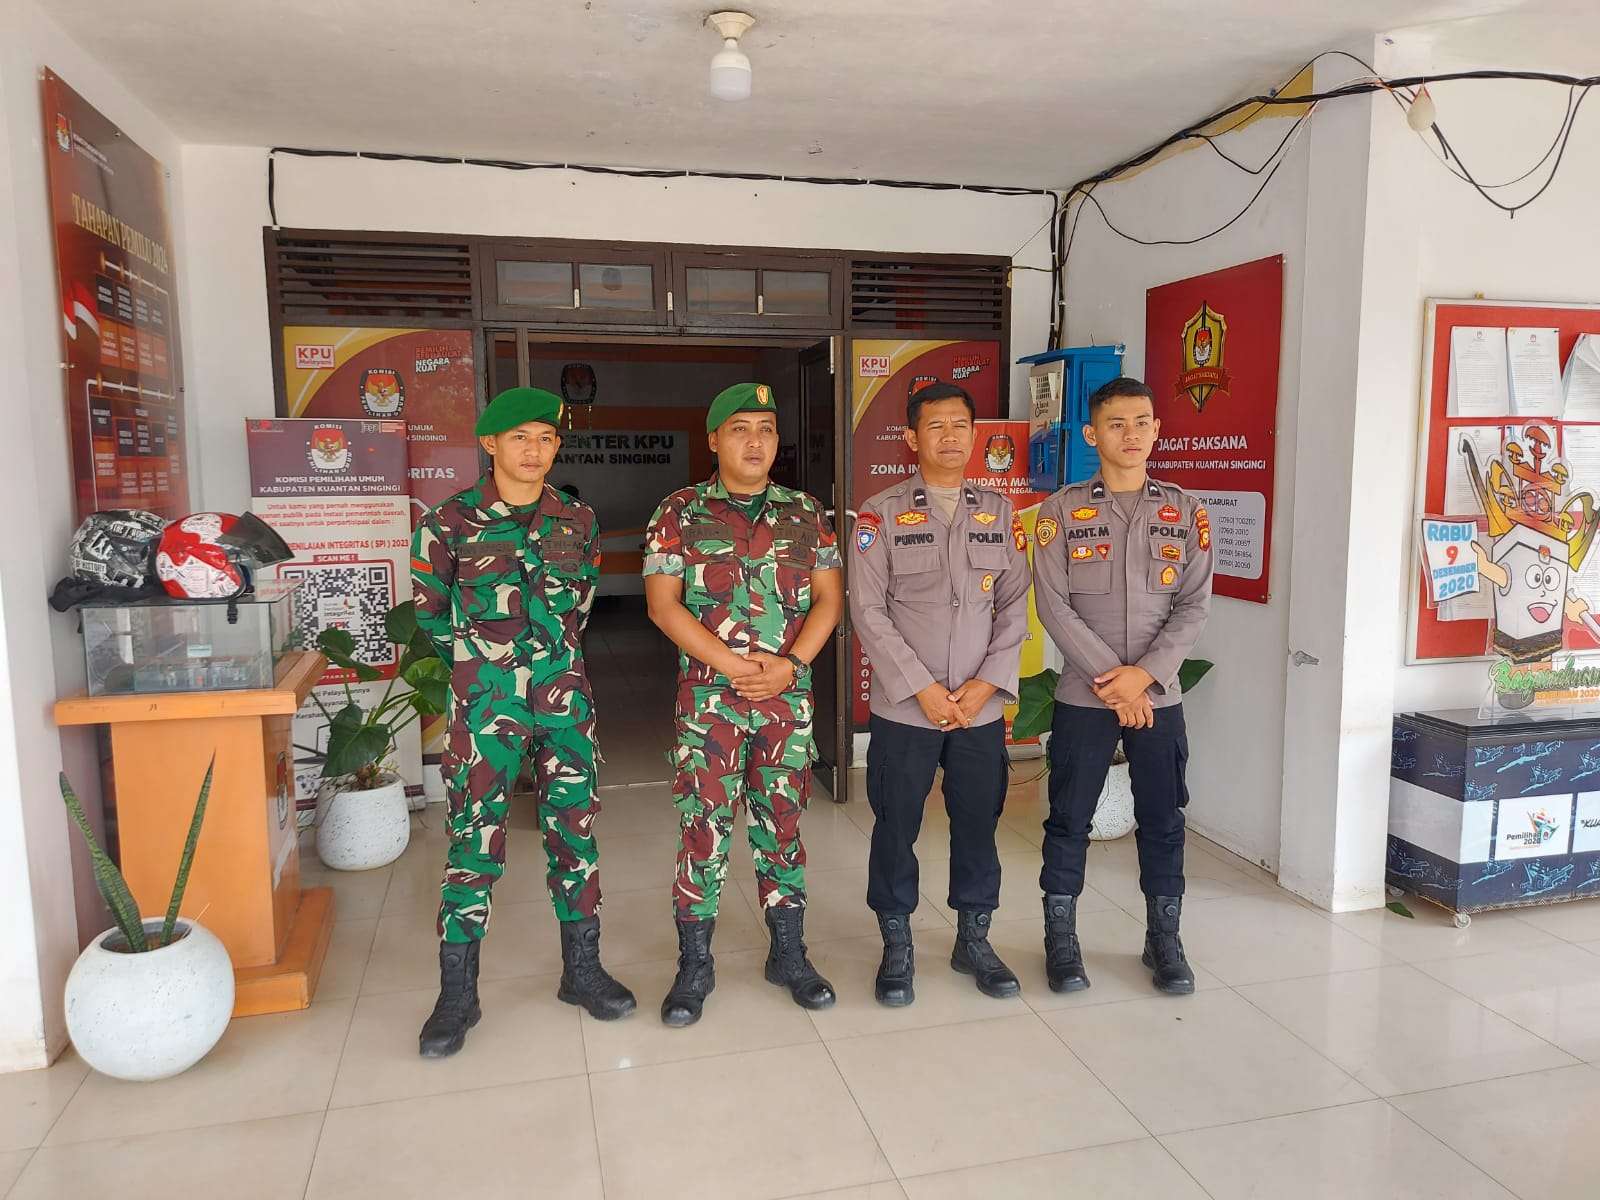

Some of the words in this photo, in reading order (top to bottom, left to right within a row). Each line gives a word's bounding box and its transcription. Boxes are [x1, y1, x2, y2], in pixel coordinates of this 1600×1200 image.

[72, 192, 120, 248] TAHAPAN
[298, 348, 331, 358] KPU
[416, 357, 450, 367] NEGARA
[861, 358, 887, 368] KPU
[416, 364, 437, 373] KUAT
[953, 365, 980, 374] NEGARA
[633, 434, 674, 449] KPU
[1157, 437, 1190, 452] JAGAT
[1192, 434, 1248, 450] SAKSANA
[554, 454, 605, 465] ANTAN
[608, 453, 671, 465] SINGINGI
[1158, 460, 1194, 469] KABUPATEN
[1195, 461, 1229, 470] KUANTAN
[1230, 459, 1266, 470] SINGINGI
[870, 464, 906, 475] ZONA
[275, 475, 308, 483] KOMISI
[309, 475, 357, 483] PEMILIHAN
[260, 485, 315, 493] KABUPATEN
[362, 484, 401, 492] SINGINGI
[1208, 497, 1238, 507] DARURAT
[1150, 526, 1188, 540] POLRI
[1427, 523, 1472, 541] RABU
[894, 532, 935, 546] PURWO
[968, 532, 1004, 544] POLRI
[327, 540, 369, 550] INTEGRITAS
[392, 539, 409, 548] 2023
[317, 556, 339, 564] SCAN
[340, 555, 351, 563] ME
[1446, 545, 1459, 566] 9
[1432, 562, 1477, 580] DESEMBER
[1438, 574, 1475, 599] 2020
[326, 621, 350, 629] KPK
[1506, 831, 1541, 841] Pemilihan
[1523, 837, 1541, 845] 2020
